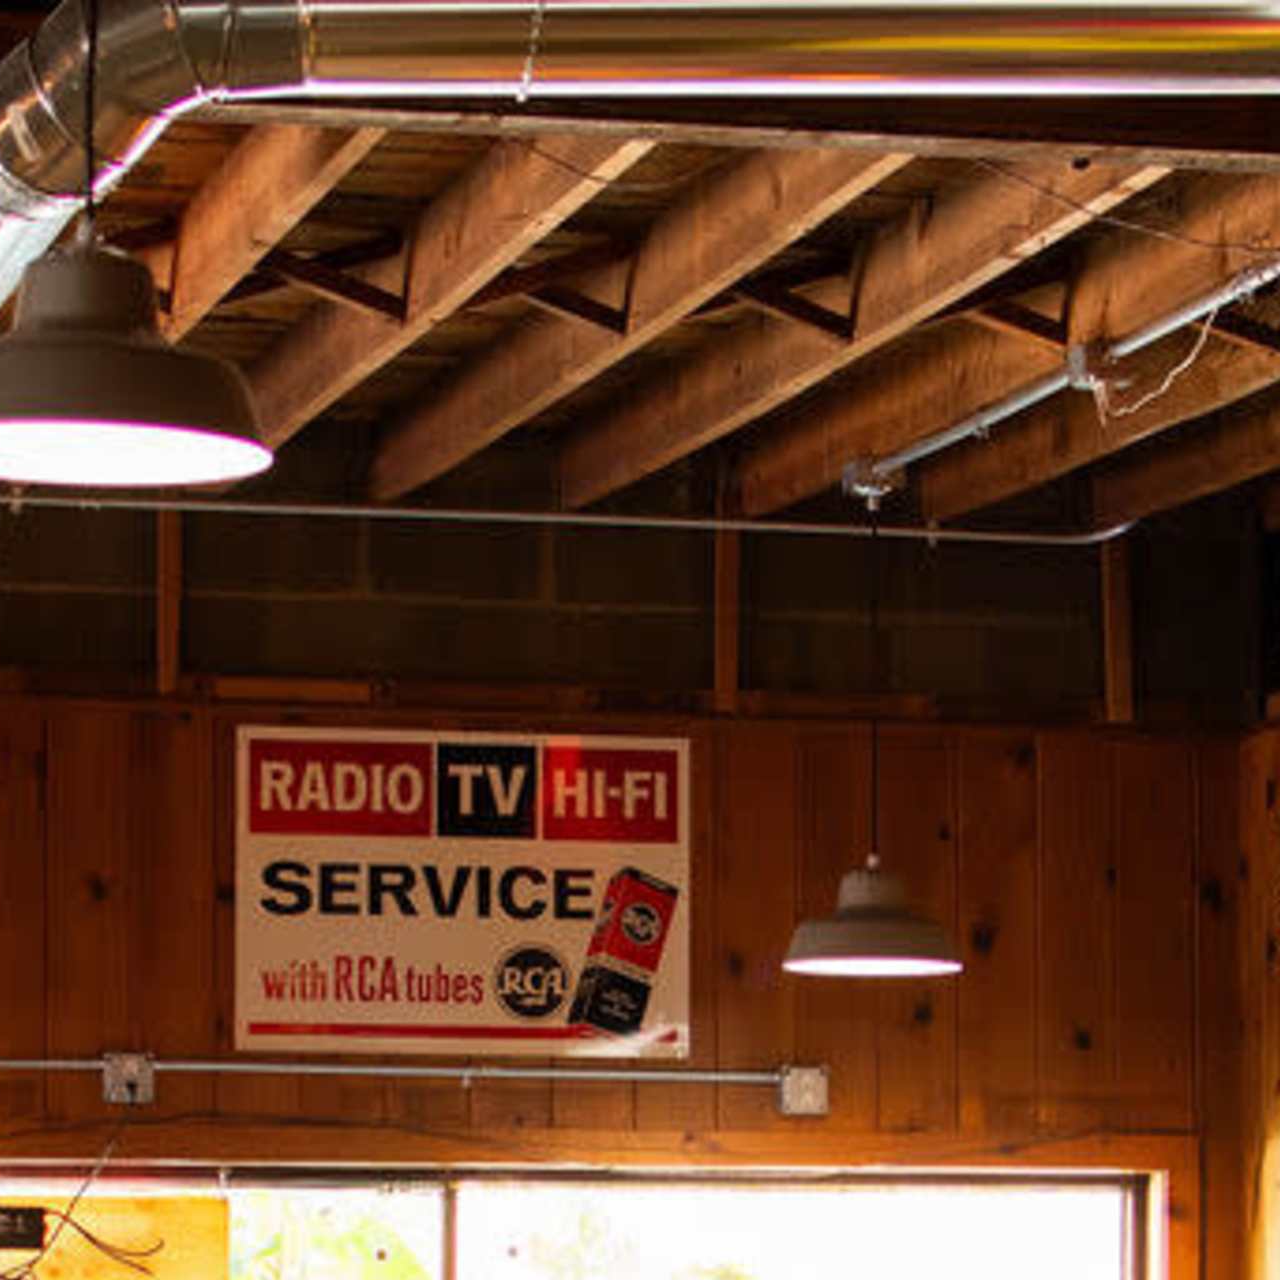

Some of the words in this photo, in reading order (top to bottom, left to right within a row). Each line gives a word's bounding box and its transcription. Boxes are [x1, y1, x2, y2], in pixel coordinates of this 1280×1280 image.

[260, 760, 424, 814] RADIO
[448, 764, 527, 817] TV
[552, 768, 668, 820] HI-FI
[260, 860, 595, 920] SERVICE
[260, 958, 327, 1002] with
[334, 955, 399, 1003] RCA
[406, 963, 484, 1005] tubes
[498, 966, 564, 996] RCA
